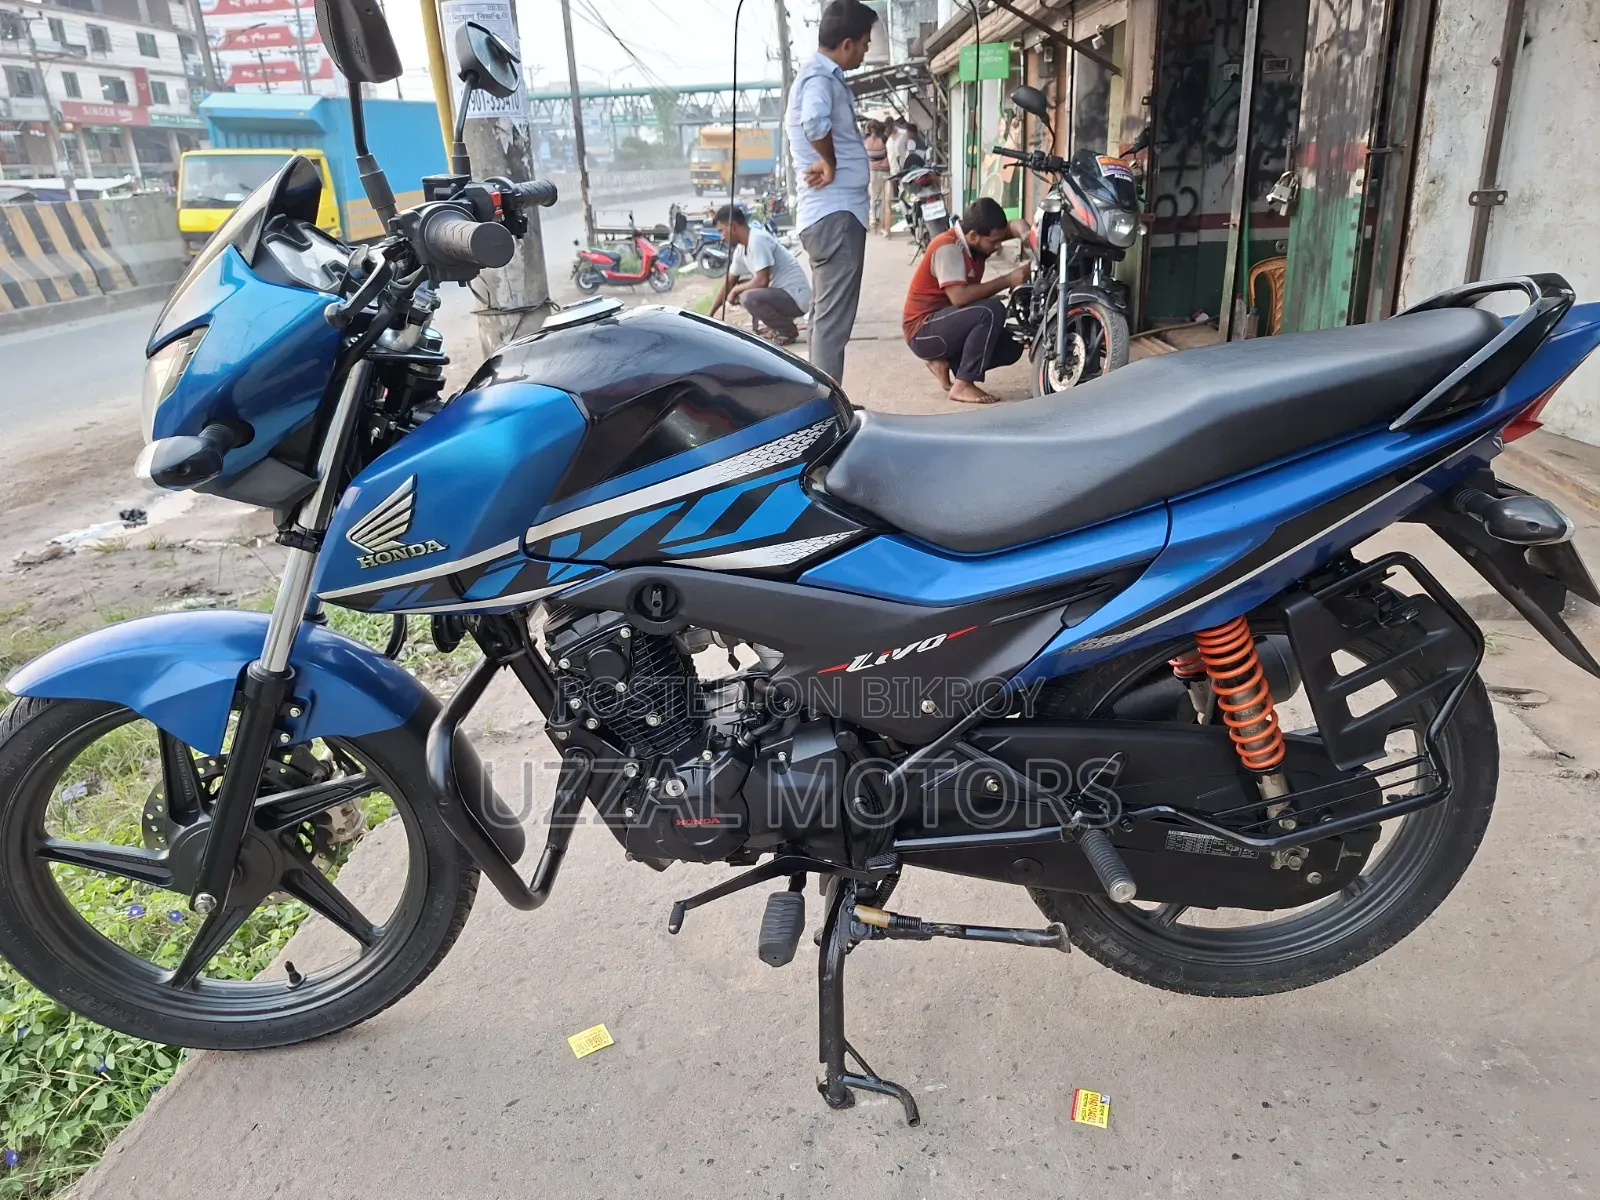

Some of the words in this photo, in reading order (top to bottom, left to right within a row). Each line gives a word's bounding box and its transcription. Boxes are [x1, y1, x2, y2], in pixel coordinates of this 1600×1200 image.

[82, 105, 116, 117] SINGER
[357, 539, 447, 568] HONDA
[675, 817, 720, 827] HONDA
